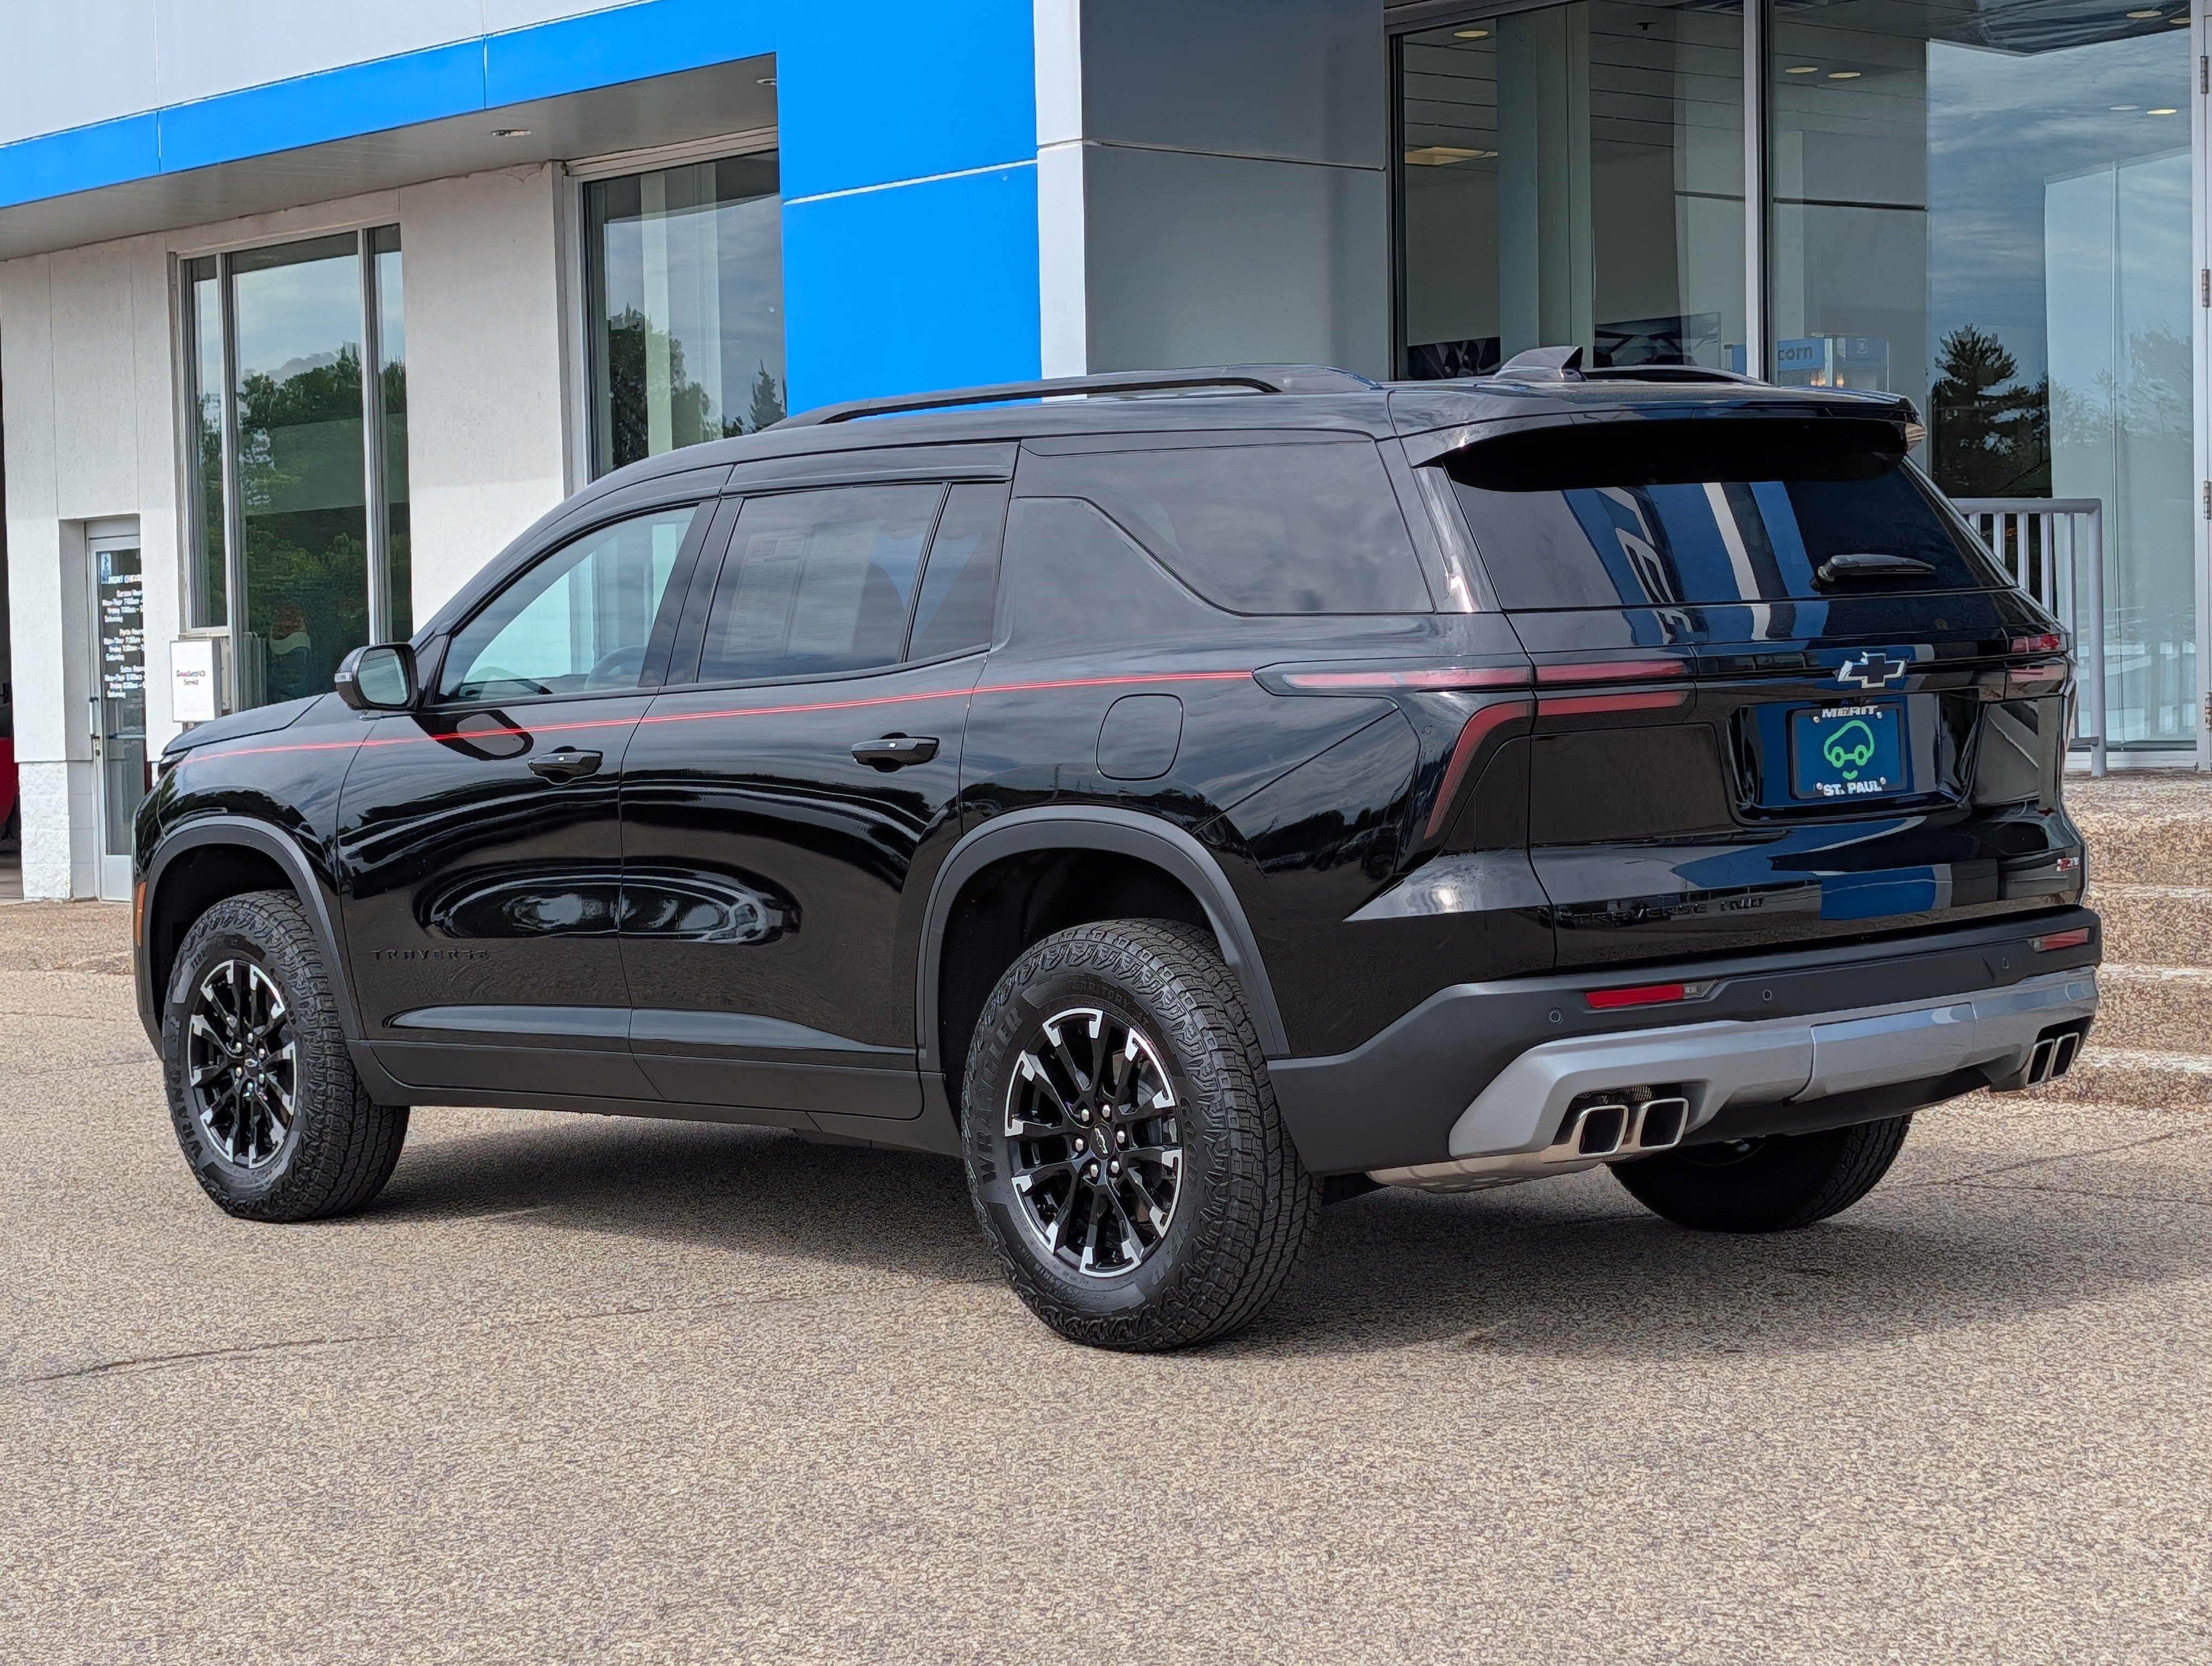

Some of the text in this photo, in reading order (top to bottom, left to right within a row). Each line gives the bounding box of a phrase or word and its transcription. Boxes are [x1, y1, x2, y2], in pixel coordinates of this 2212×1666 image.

[1822, 706, 1877, 717] MERIT
[1823, 781, 1882, 796] ST. PAUL
[976, 1007, 1025, 1184] WRANGLER
